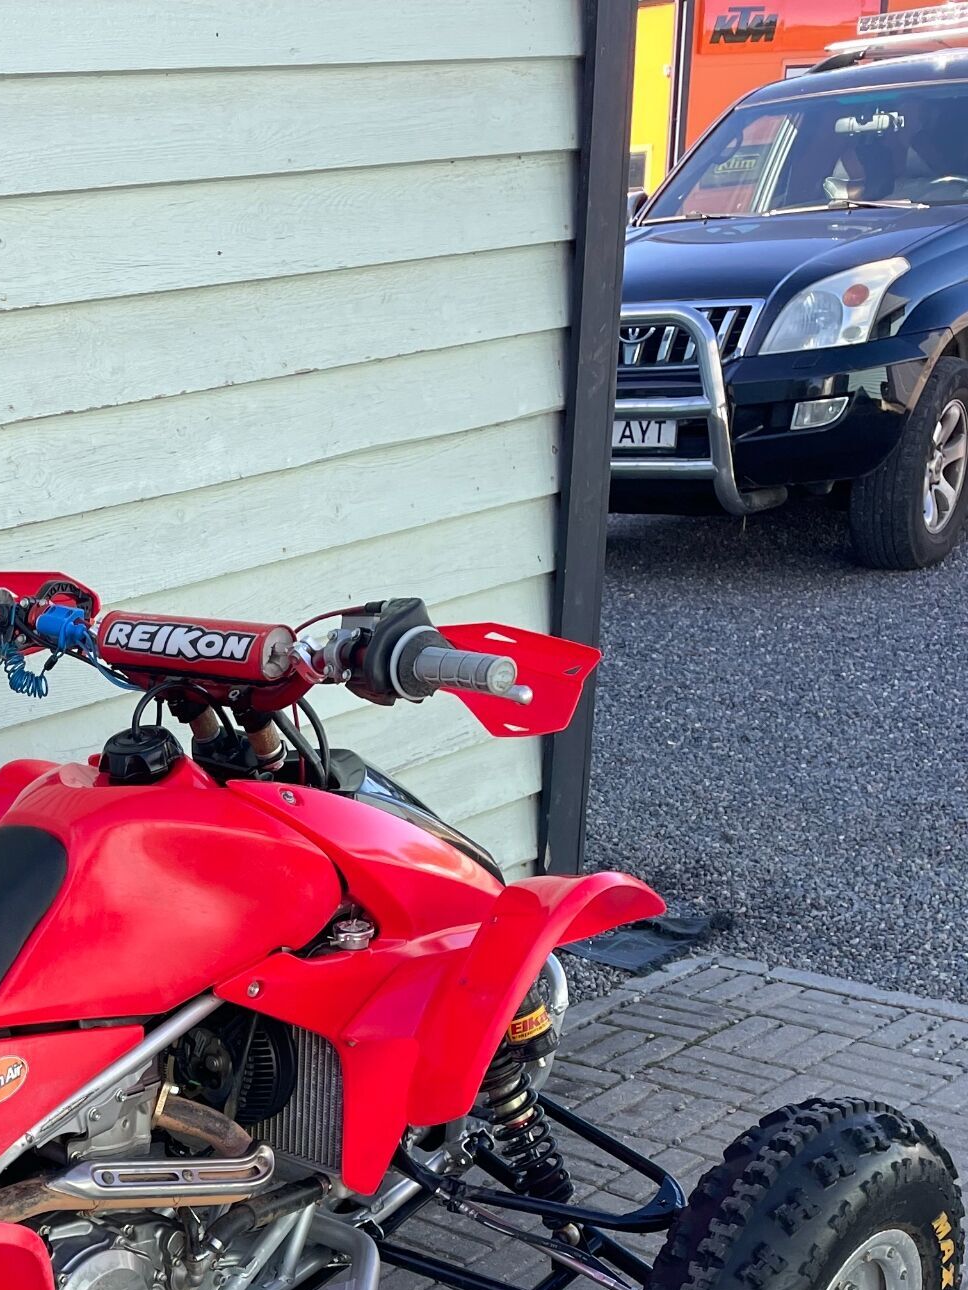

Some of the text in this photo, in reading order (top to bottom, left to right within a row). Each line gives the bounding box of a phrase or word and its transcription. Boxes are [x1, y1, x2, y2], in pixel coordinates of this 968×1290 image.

[709, 6, 778, 44] KTM
[618, 420, 667, 444] AYT
[107, 622, 253, 659] REIKON
[5, 1061, 24, 1084] Air
